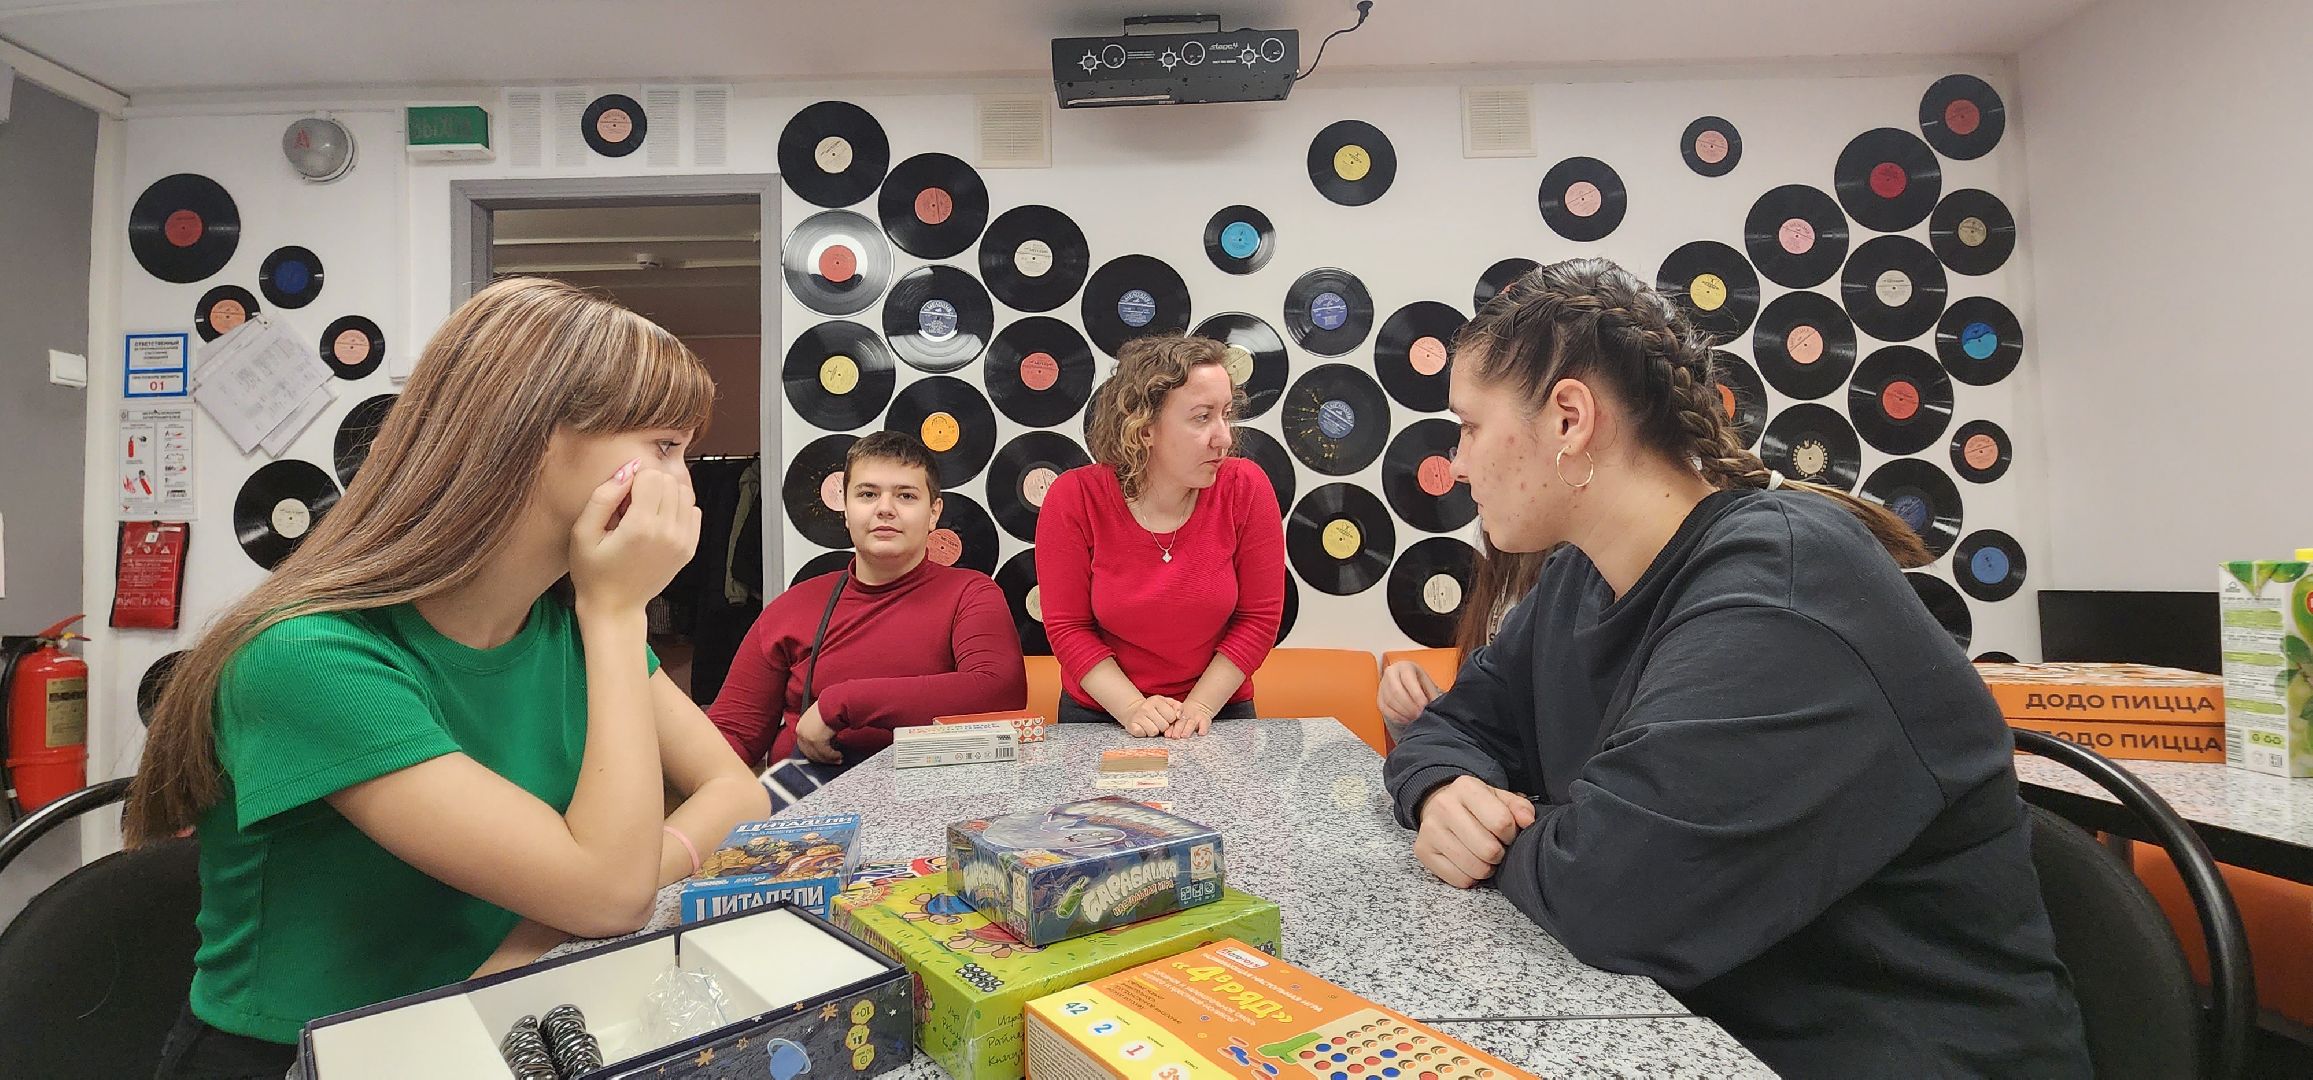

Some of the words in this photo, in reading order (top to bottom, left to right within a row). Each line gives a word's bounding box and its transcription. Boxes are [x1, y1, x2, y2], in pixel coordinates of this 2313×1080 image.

[149, 381, 165, 391] 01
[2025, 692, 2105, 711] ДОДО
[2111, 694, 2216, 713] ПИЦЦА
[2120, 733, 2223, 753] ПИЦЦА
[1065, 1002, 1089, 1015] 42
[1093, 1023, 1113, 1034] 2
[1126, 1044, 1145, 1056] 1
